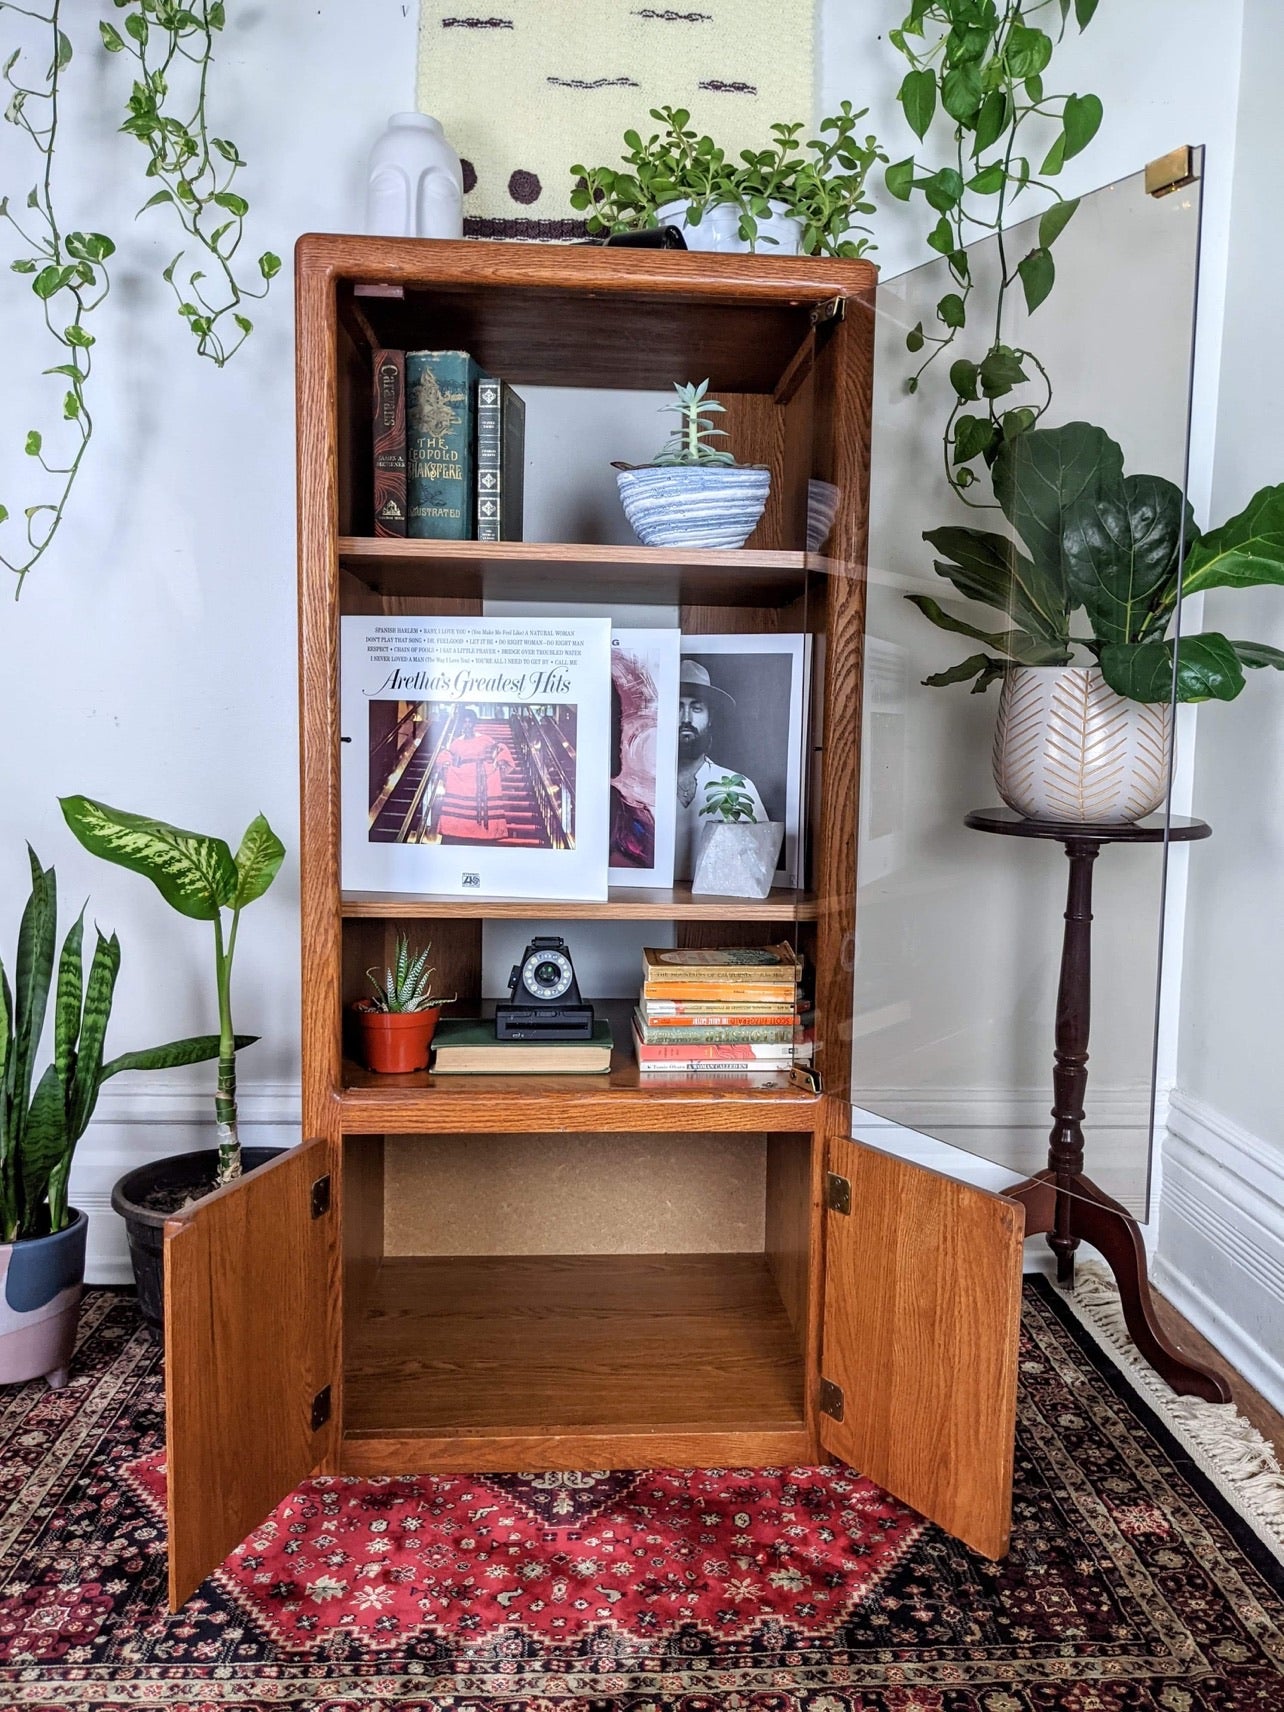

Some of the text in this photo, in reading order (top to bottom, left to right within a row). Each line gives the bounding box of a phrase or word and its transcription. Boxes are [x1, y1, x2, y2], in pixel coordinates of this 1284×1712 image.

[381, 364, 399, 426] Caravans
[417, 437, 449, 449] THE
[362, 666, 571, 700] Aretha's Greatest Hits
